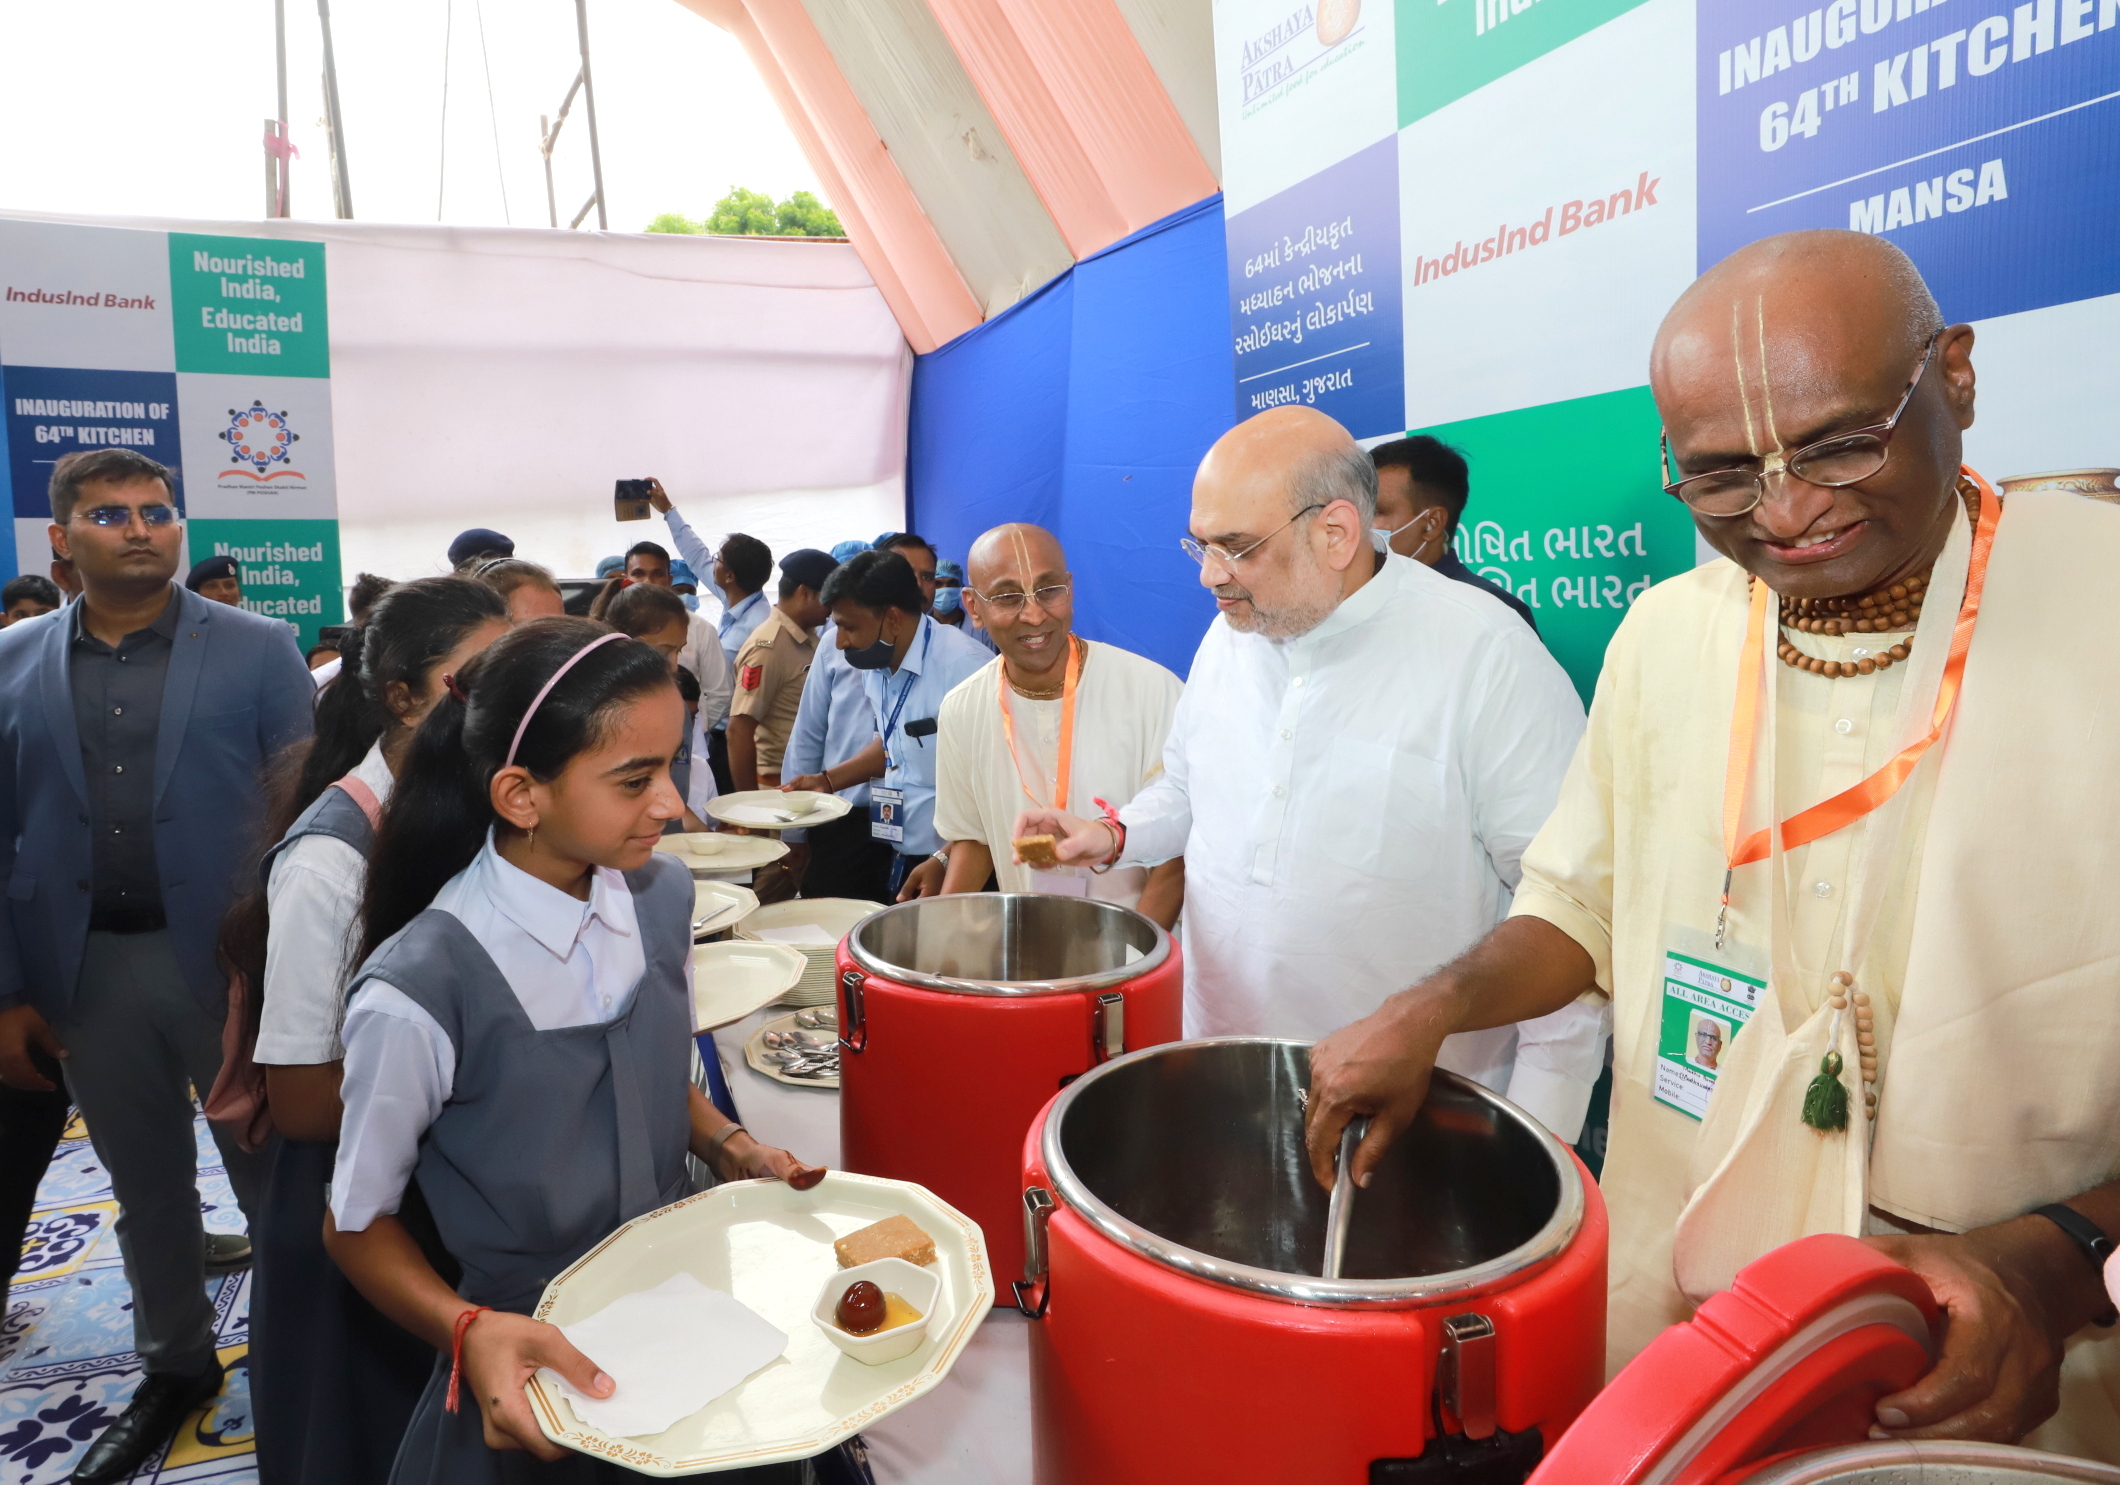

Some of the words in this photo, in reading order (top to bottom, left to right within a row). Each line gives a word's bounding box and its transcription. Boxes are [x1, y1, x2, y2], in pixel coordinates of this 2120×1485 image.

[1240, 3, 1315, 71] AKSHAYA
[1759, 71, 1859, 152] 64TH
[1849, 158, 2008, 235] MANSA
[1413, 207, 1555, 287] IndusInd
[1557, 170, 1662, 237] Bank
[193, 250, 305, 279] Nourished
[1298, 253, 1363, 295] ભોજનના
[6, 286, 101, 307] IndusInd
[103, 293, 156, 310] Bank
[220, 276, 281, 303] India,
[201, 307, 303, 332] Educated
[227, 332, 281, 355] India
[1302, 368, 1353, 404] ગુજરાત
[15, 398, 146, 419] INAUGURATION
[148, 402, 170, 420] OF
[35, 425, 74, 444] 64TH
[77, 426, 155, 446] KITCHEN
[214, 541, 323, 562] Nourished
[1543, 522, 1648, 561] ભારત
[241, 564, 300, 587] India,
[237, 595, 322, 615] ducated
[1670, 985, 1688, 998] ALL
[1690, 991, 1717, 1008] AREA
[1719, 1004, 1750, 1021] ACCES
